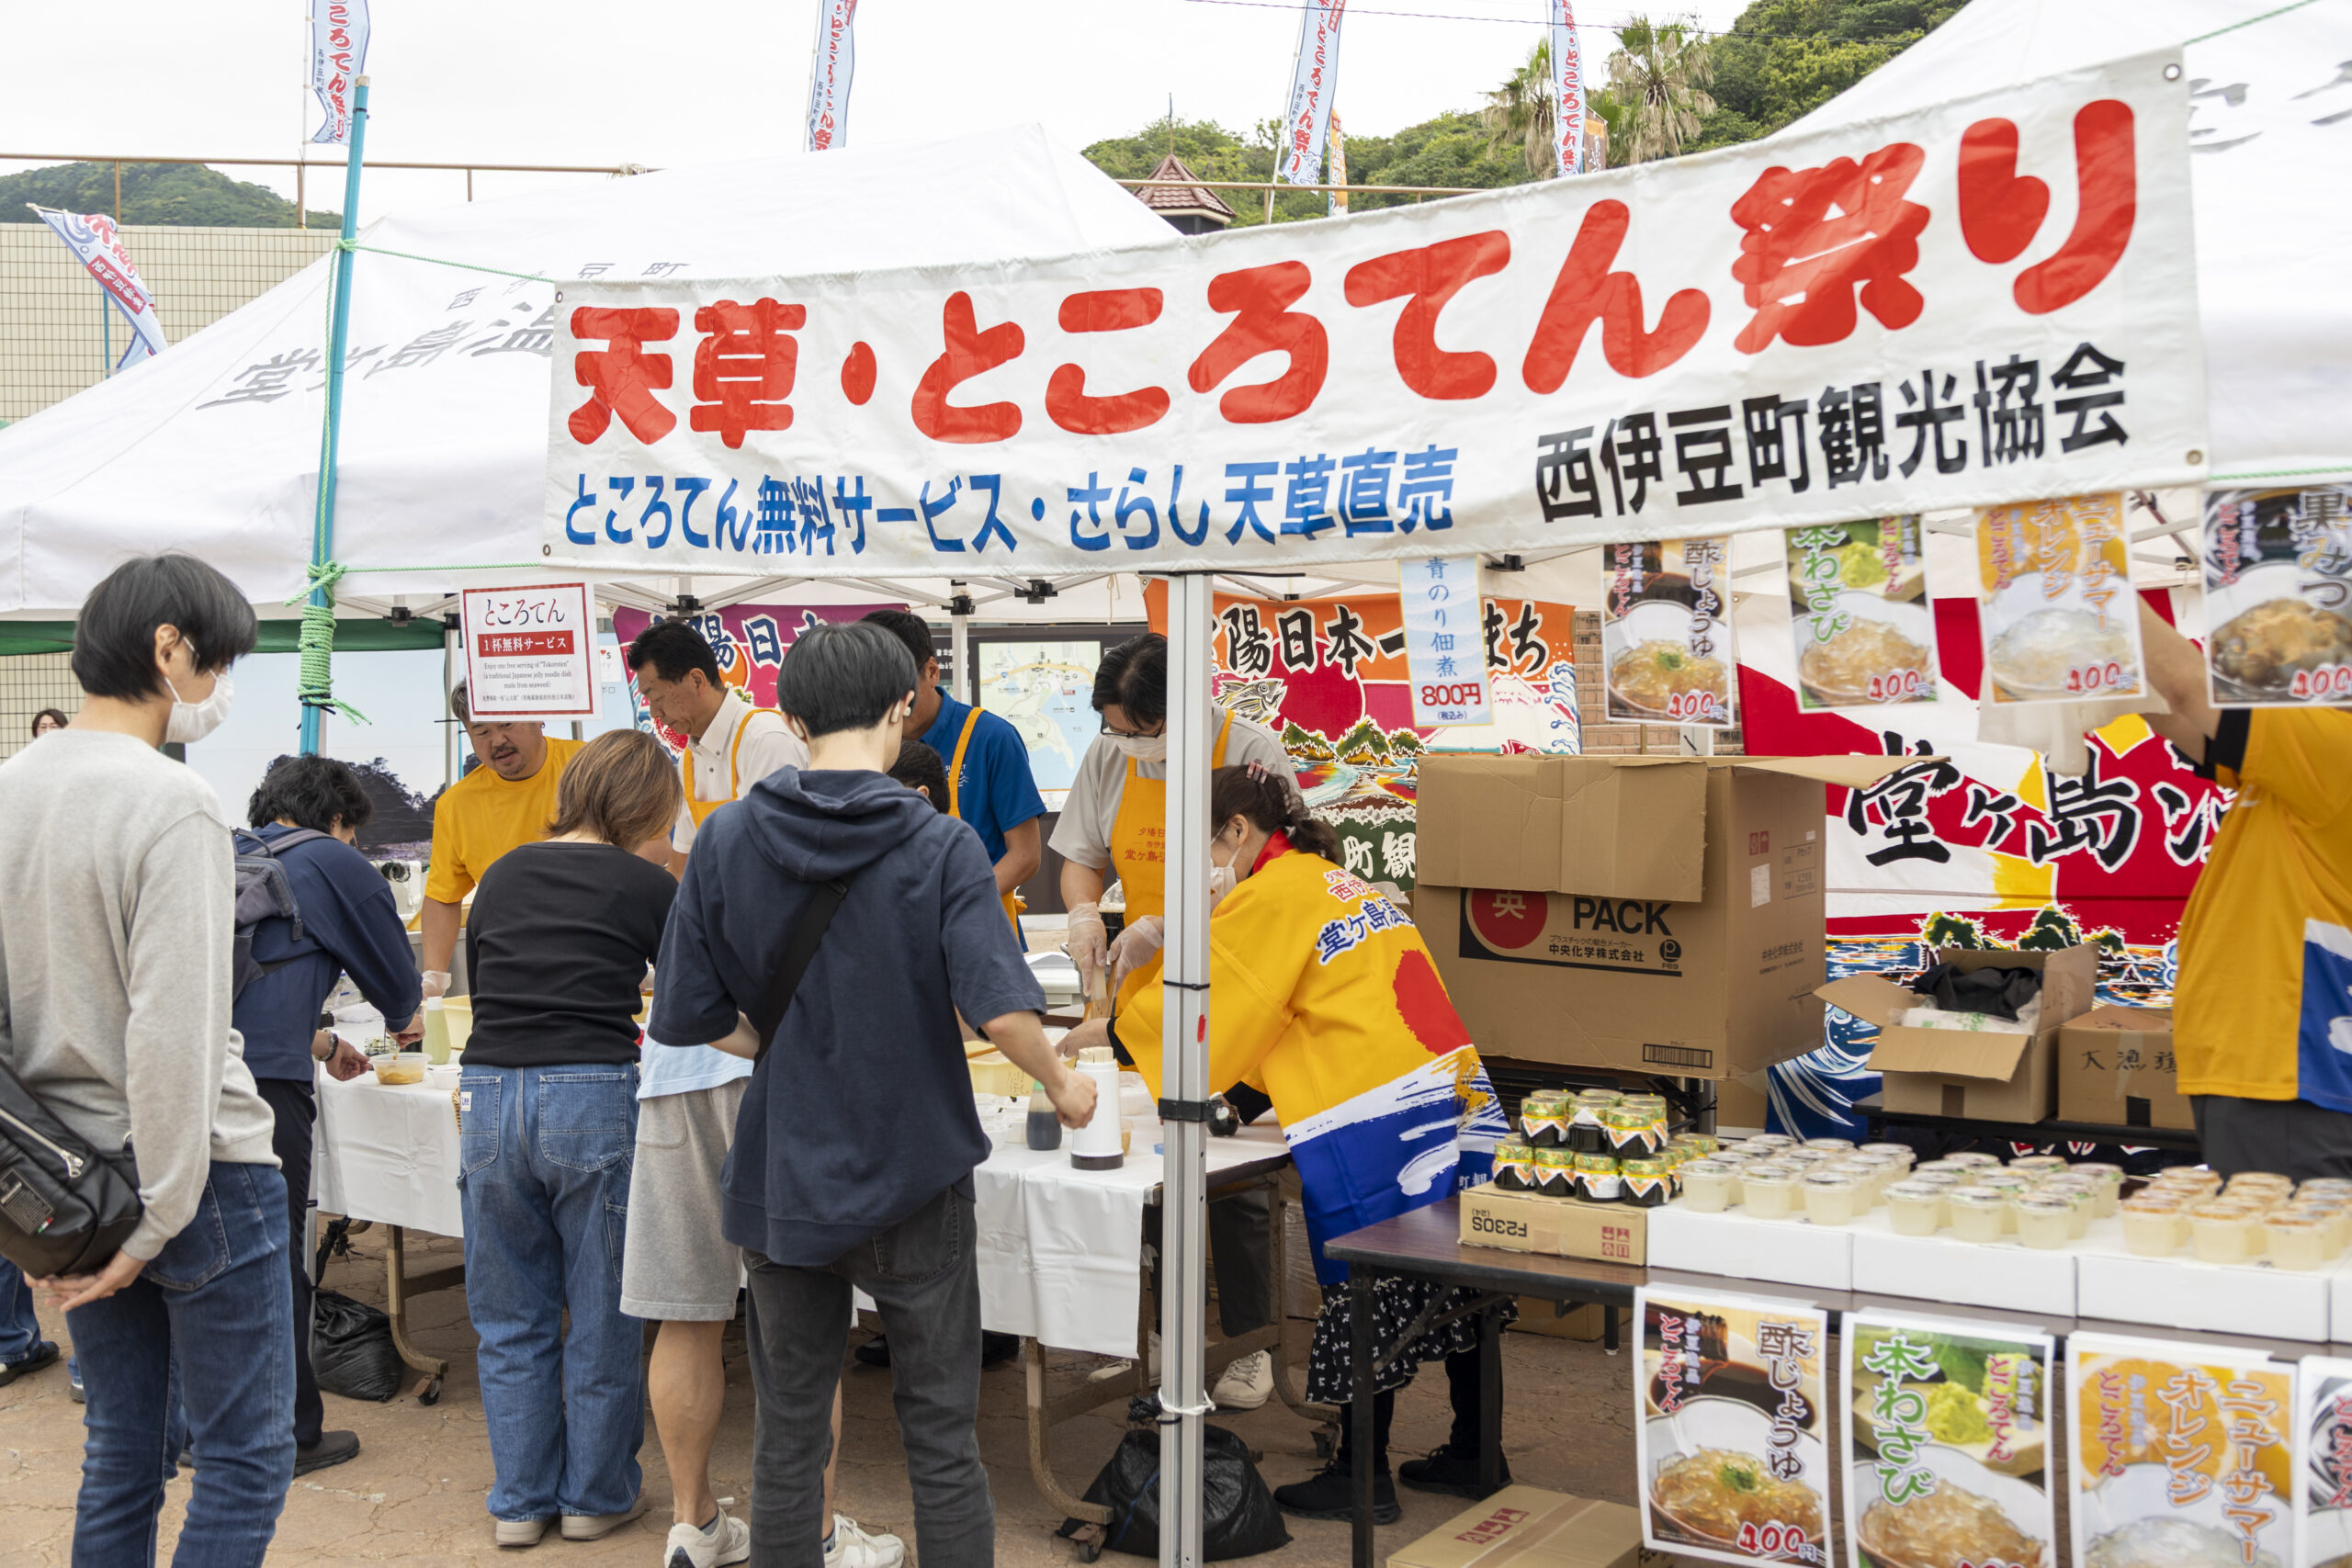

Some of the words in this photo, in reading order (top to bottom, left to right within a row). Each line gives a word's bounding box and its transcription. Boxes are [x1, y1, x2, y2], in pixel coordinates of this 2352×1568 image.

[328, 0, 352, 139] ころてん祭り
[566, 97, 2138, 449] 天草・ところてん祭り
[1536, 343, 2129, 523] 西伊豆町観光協会
[565, 444, 1458, 557] ところてん無料サービス・さらし天草直売
[1989, 512, 2012, 590] ところてん
[2219, 503, 2240, 585] ところてん
[485, 599, 565, 626] ところてん
[1426, 557, 1457, 678] 青のり佃煮
[1685, 541, 1724, 658] 酢じょうゆ
[1794, 526, 1849, 643] 本わさび
[1421, 682, 1482, 706] 800円
[1549, 943, 1645, 963] 中央化学株式会社
[1573, 897, 1673, 937] PACK
[1472, 1216, 1527, 1237] F230S
[1659, 1313, 1683, 1412] ところてん
[1758, 1322, 1815, 1481] 酢じょうゆ
[1987, 1354, 2013, 1462] ところてん
[1864, 1337, 1939, 1505] 本わさび
[2098, 1370, 2126, 1477] ところてん
[2159, 1371, 2213, 1505] オレンジ
[2221, 1381, 2278, 1562] ニューサマー
